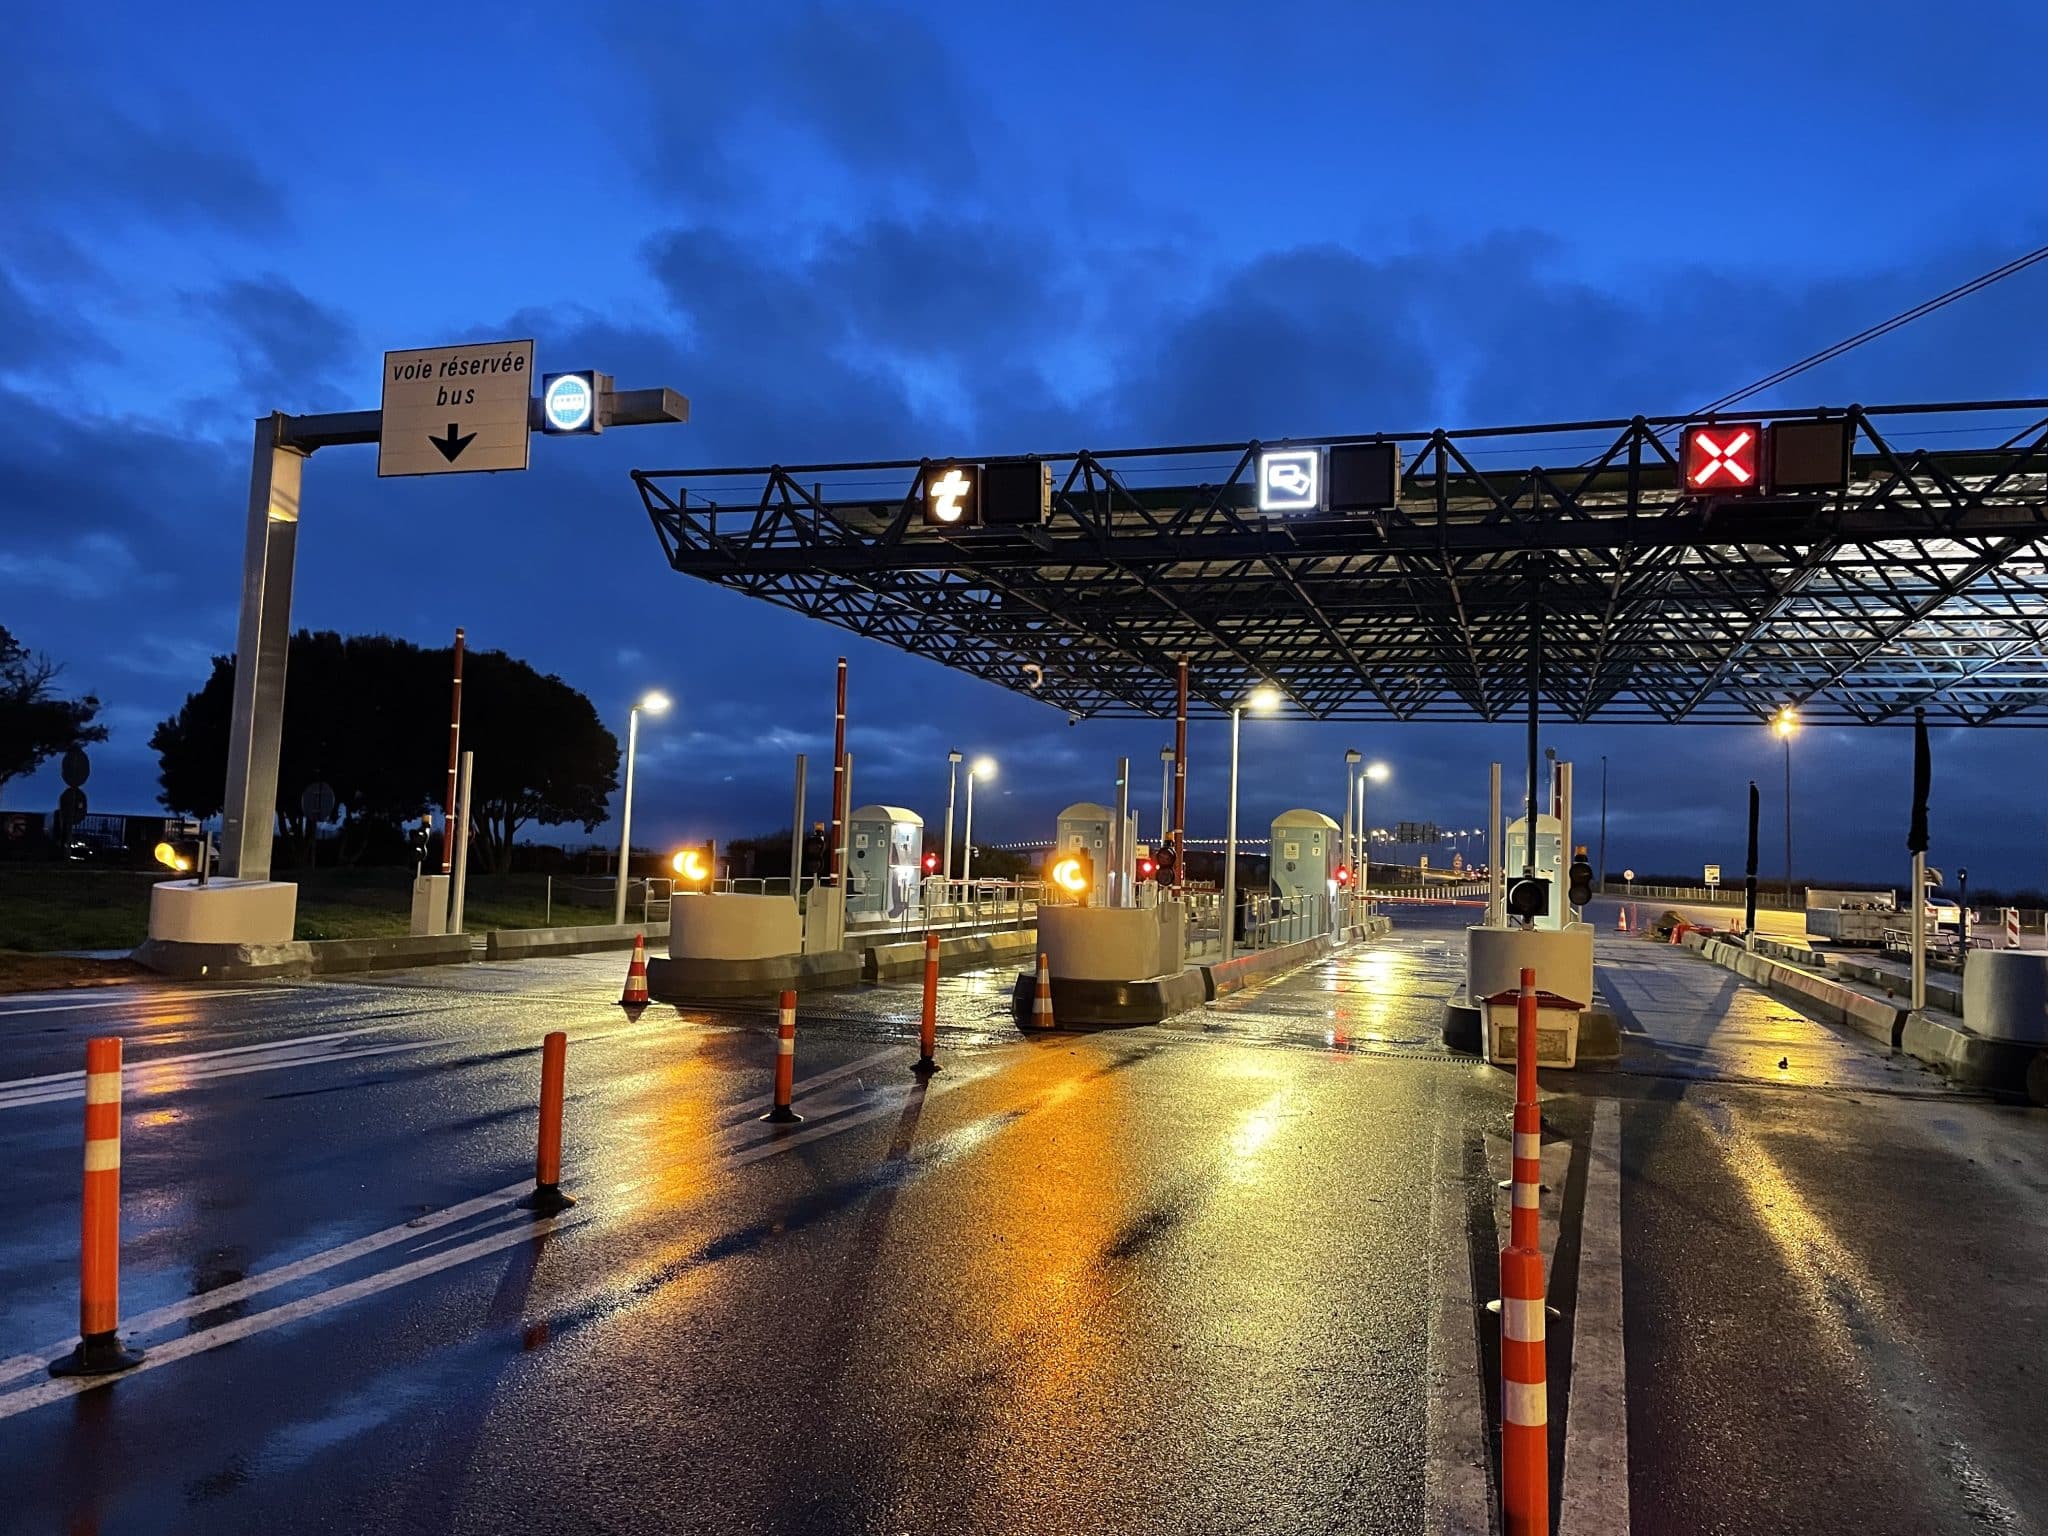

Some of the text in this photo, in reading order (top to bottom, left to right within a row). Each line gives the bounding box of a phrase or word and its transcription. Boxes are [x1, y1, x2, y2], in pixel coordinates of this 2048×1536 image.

[394, 352, 524, 380] voie réservée
[436, 386, 475, 406] bus
[930, 469, 971, 521] t
